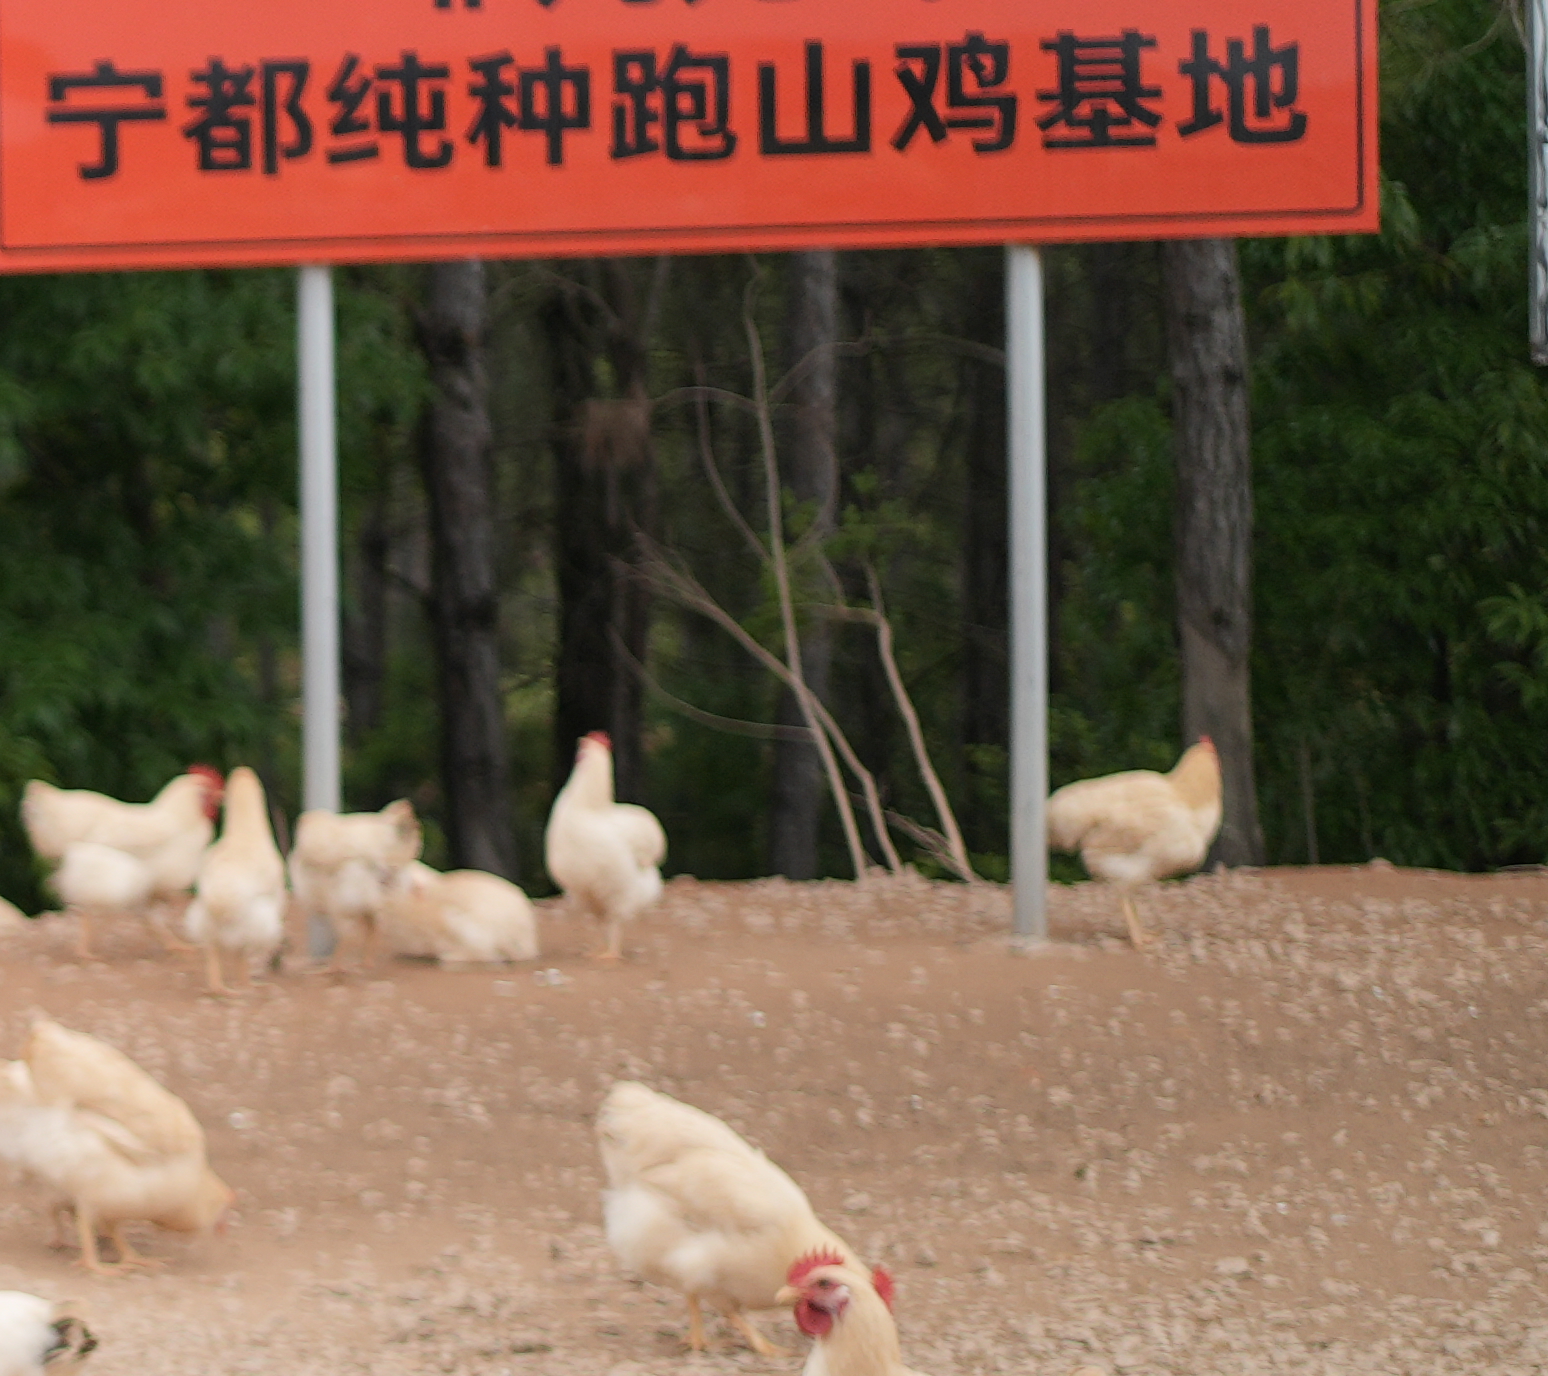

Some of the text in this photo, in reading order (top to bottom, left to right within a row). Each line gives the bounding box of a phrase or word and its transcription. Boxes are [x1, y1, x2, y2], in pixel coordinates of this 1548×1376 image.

[45, 25, 1309, 181] 宁都纯种跑山鸡基地
